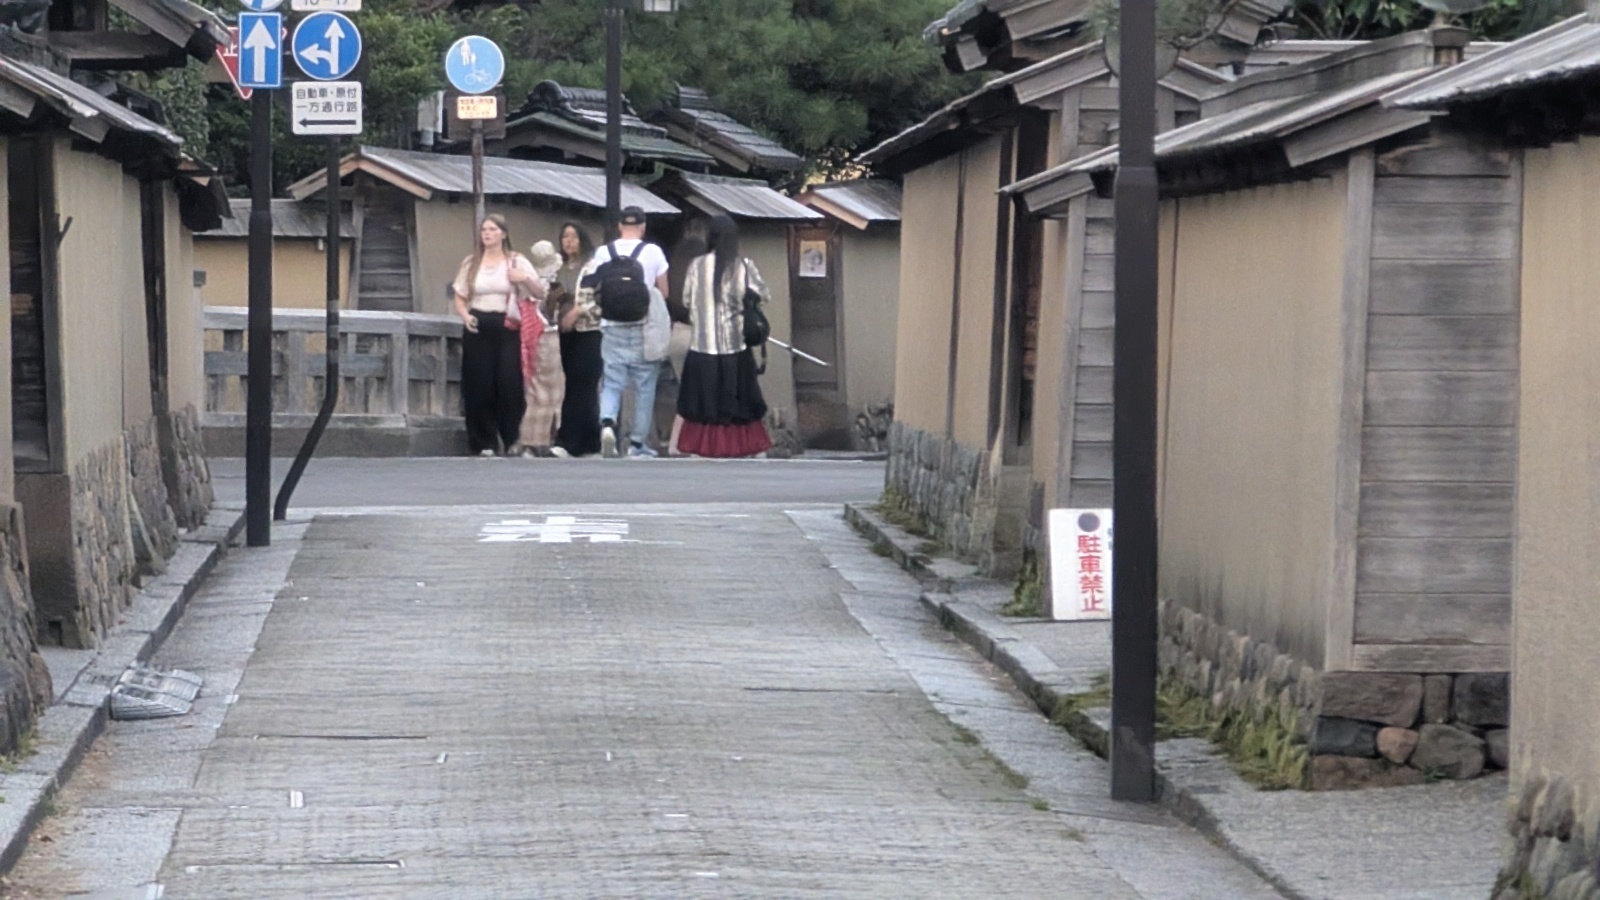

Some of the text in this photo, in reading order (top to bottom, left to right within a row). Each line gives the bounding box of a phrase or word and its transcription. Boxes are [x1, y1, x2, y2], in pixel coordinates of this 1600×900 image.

[296, 87, 357, 99] 自動車・原付
[296, 101, 357, 113] 一方通行路
[1077, 534, 1104, 612] 駐車禁止
